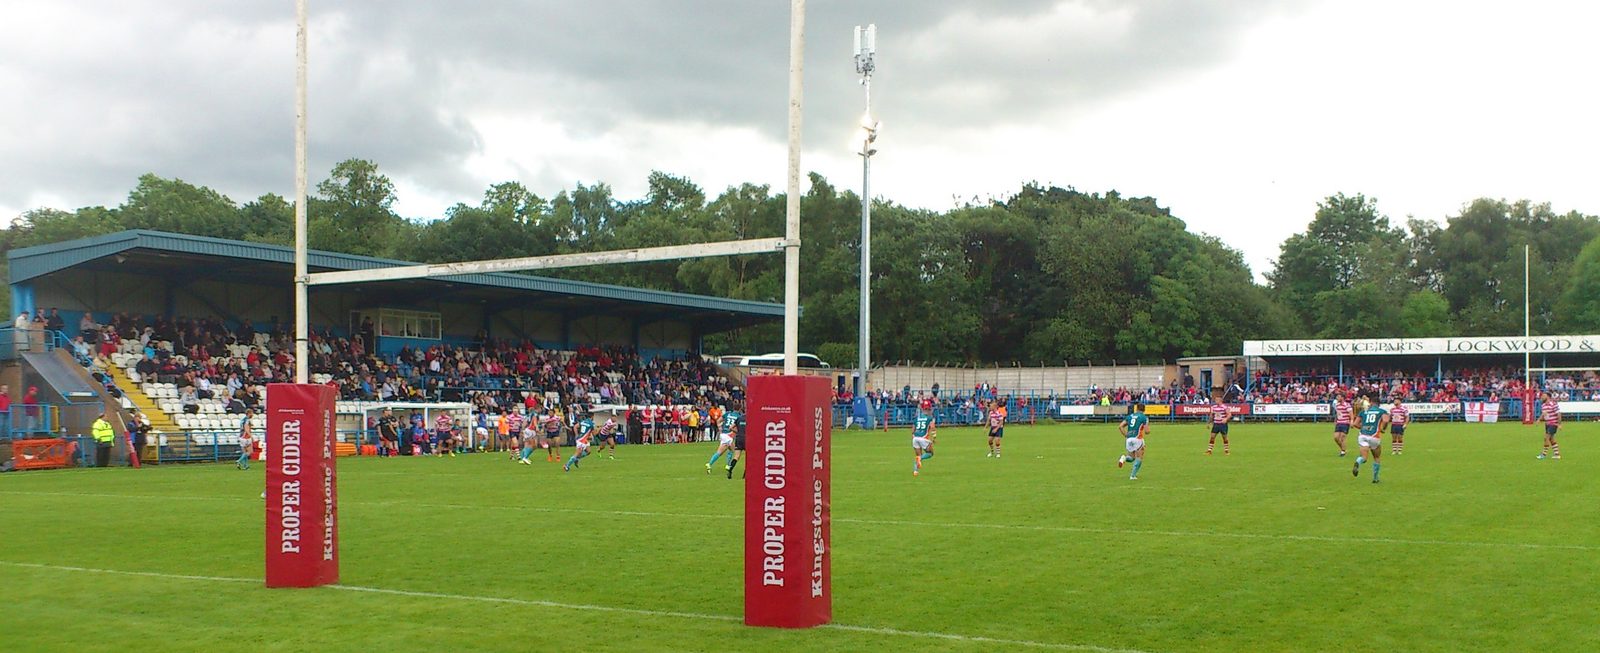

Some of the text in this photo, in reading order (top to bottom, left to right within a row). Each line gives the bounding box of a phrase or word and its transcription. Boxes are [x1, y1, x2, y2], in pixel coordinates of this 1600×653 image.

[1267, 343, 1312, 352] SALES
[1447, 339, 1594, 352] LOCKWOOD &
[916, 421, 926, 429] 35
[1130, 418, 1136, 427] 9
[1365, 413, 1376, 423] 10
[282, 419, 301, 475] CIDER
[764, 419, 787, 490] CIDER
[323, 409, 334, 561] Kingstone Press
[811, 407, 825, 598] Kingstone Press
[281, 480, 301, 554] PROPER
[763, 496, 785, 587] PROPER
